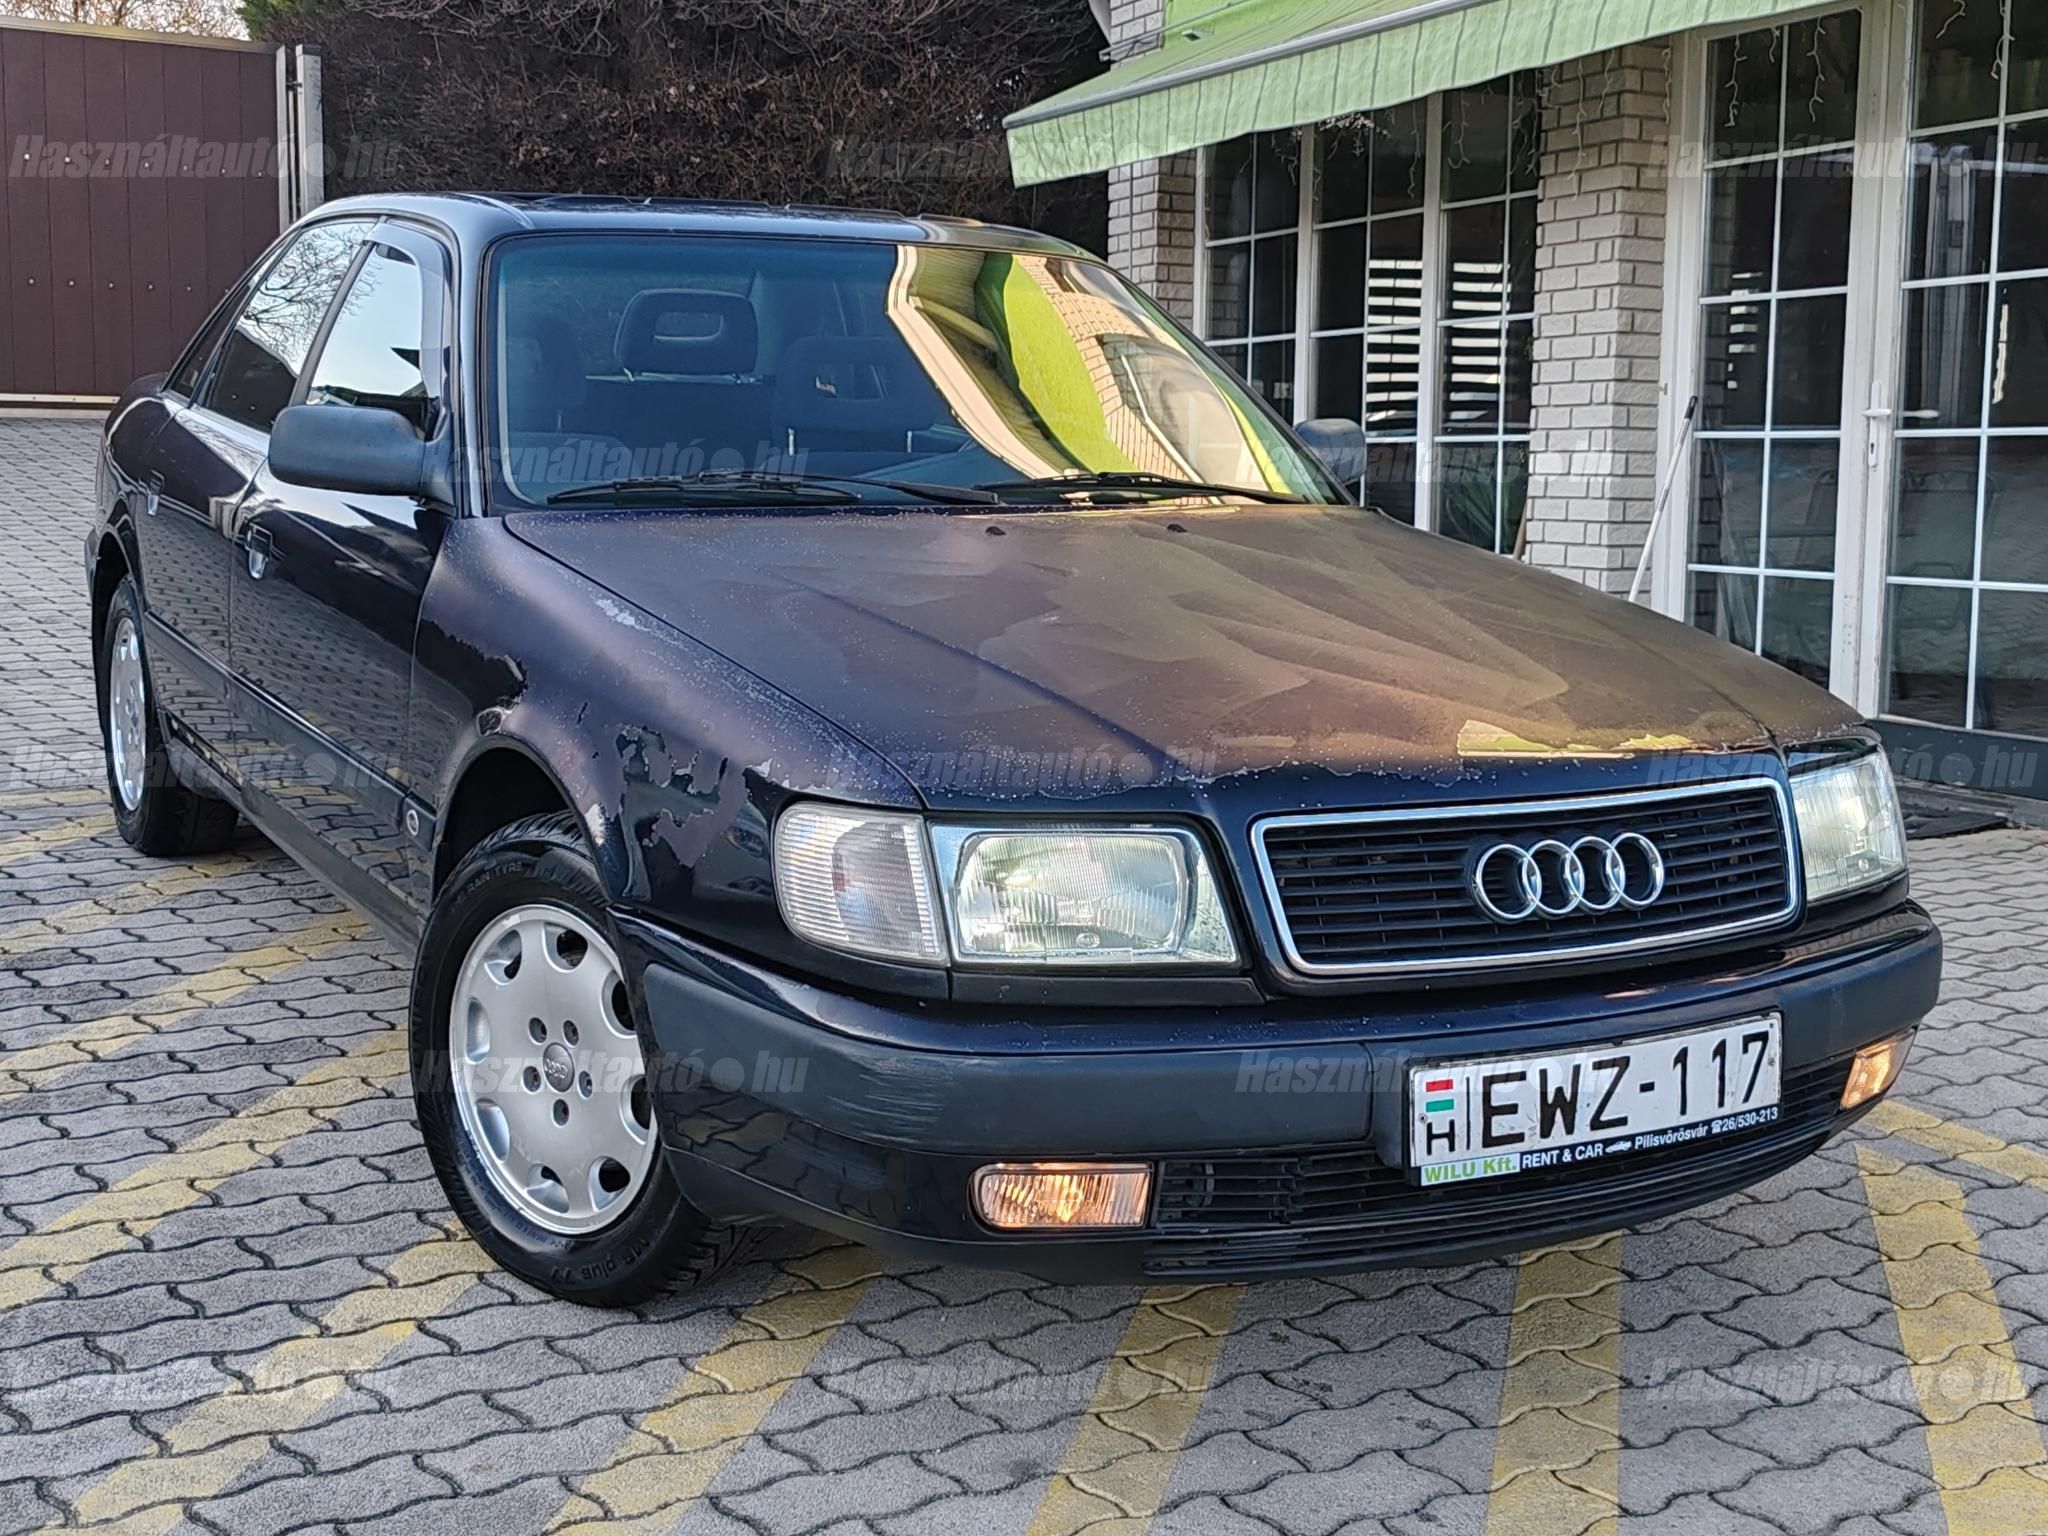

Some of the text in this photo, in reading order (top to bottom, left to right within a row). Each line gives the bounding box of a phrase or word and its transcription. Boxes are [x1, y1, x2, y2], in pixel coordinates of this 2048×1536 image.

[1481, 1030, 1770, 1149] EWZ-117
[1426, 1118, 1456, 1156] H
[1424, 1161, 1477, 1183] WILU
[1483, 1157, 1518, 1176] Kft.
[1521, 1151, 1560, 1169] RENT
[1562, 1149, 1573, 1163] &
[1575, 1143, 1604, 1161] CAR
